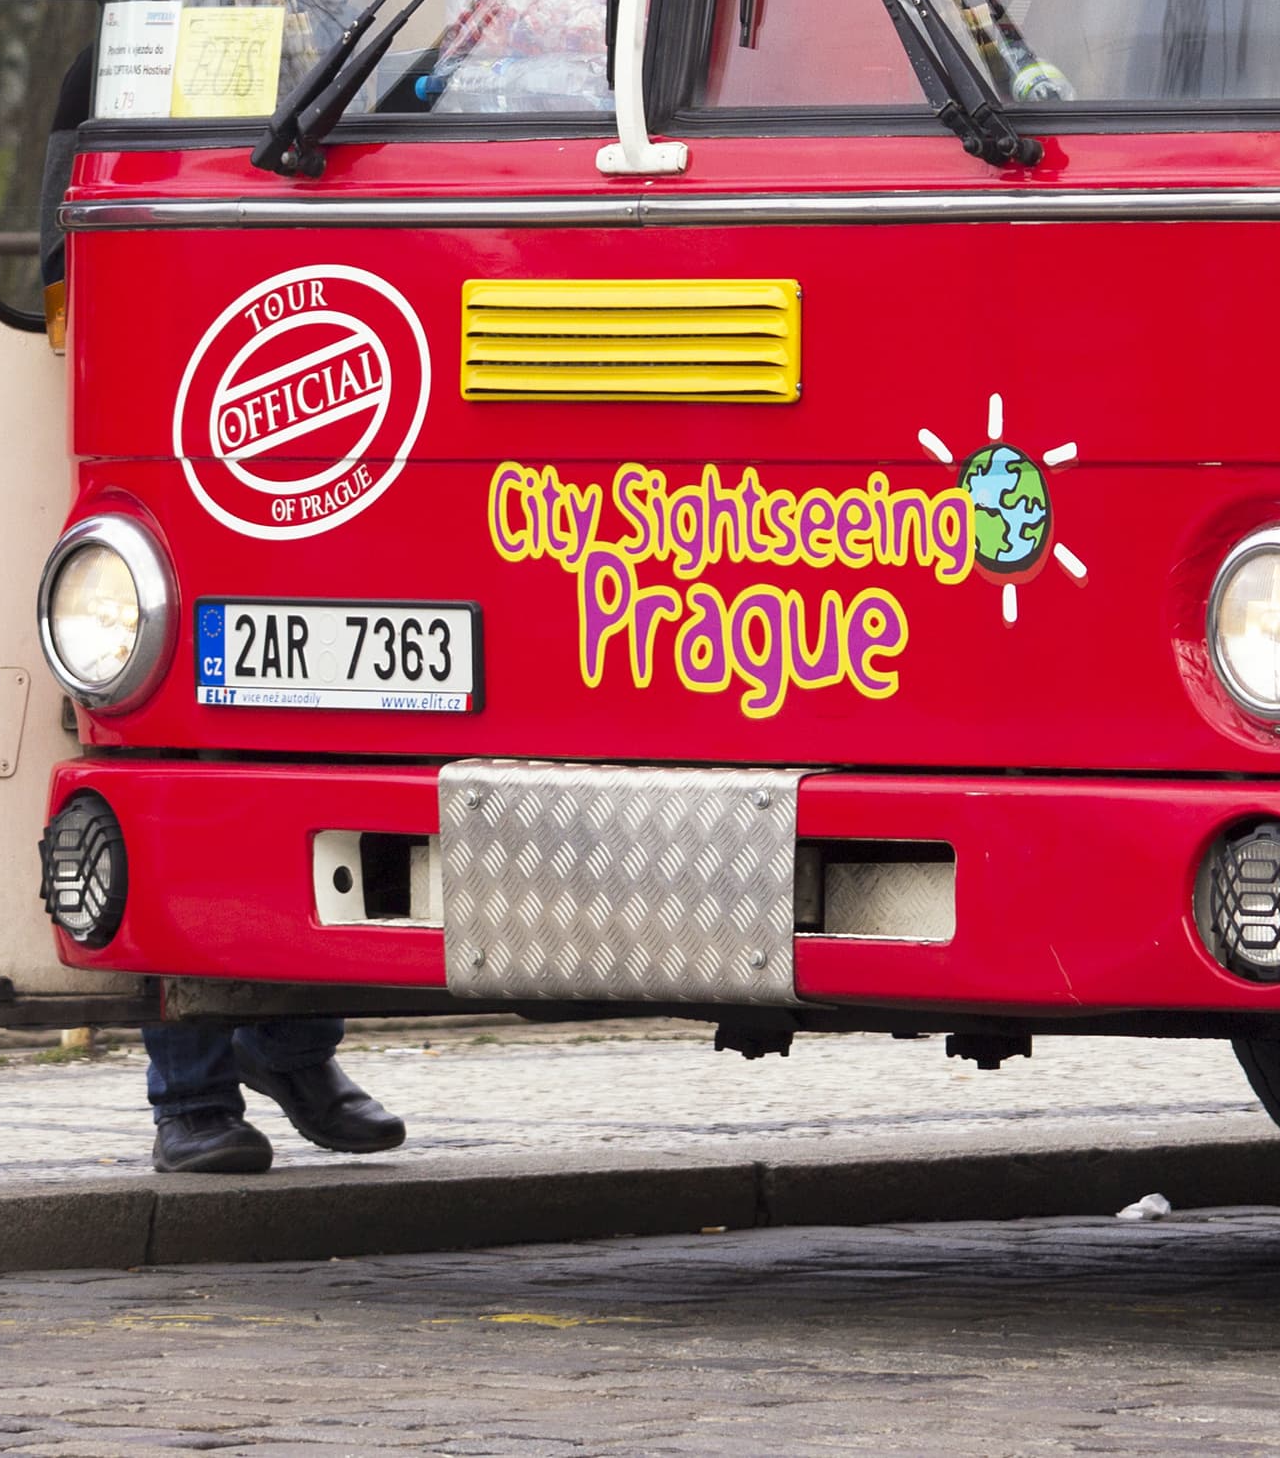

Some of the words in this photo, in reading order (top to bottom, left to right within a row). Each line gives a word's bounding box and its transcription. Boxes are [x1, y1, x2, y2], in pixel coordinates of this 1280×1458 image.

[244, 279, 328, 333] TOUR
[219, 350, 383, 449] OFFICIAL
[271, 497, 297, 523] OF
[301, 463, 374, 520] PRAGUE
[488, 461, 603, 572] City
[613, 462, 976, 584] Sightseeing
[234, 613, 310, 679] 2AR
[345, 616, 452, 682] 7363
[579, 543, 909, 720] Prague
[203, 657, 223, 676] CZ
[381, 693, 462, 710] www.elit.cz
